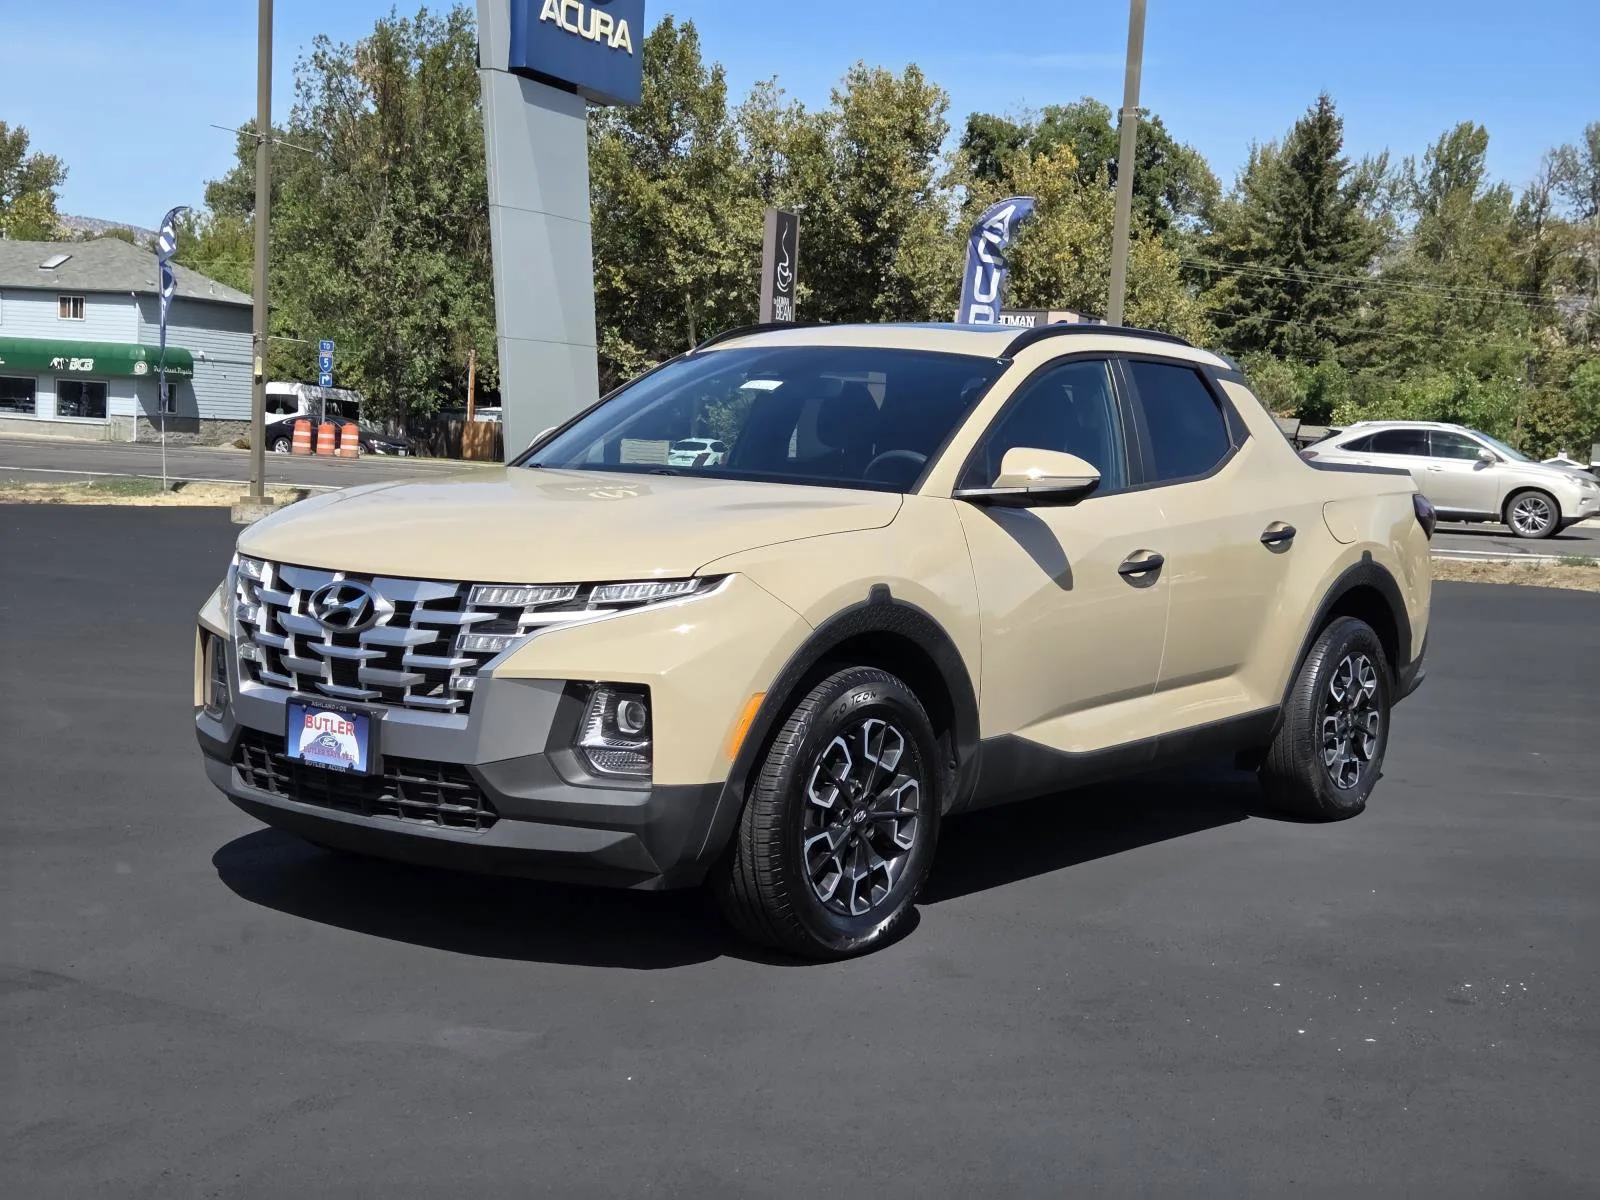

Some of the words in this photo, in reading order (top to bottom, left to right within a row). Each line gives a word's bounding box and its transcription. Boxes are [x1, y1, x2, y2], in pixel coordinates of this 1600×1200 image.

[540, 0, 633, 54] ACURA
[776, 305, 792, 321] BEAN
[323, 358, 329, 367] 5
[305, 714, 355, 736] BUTLER
